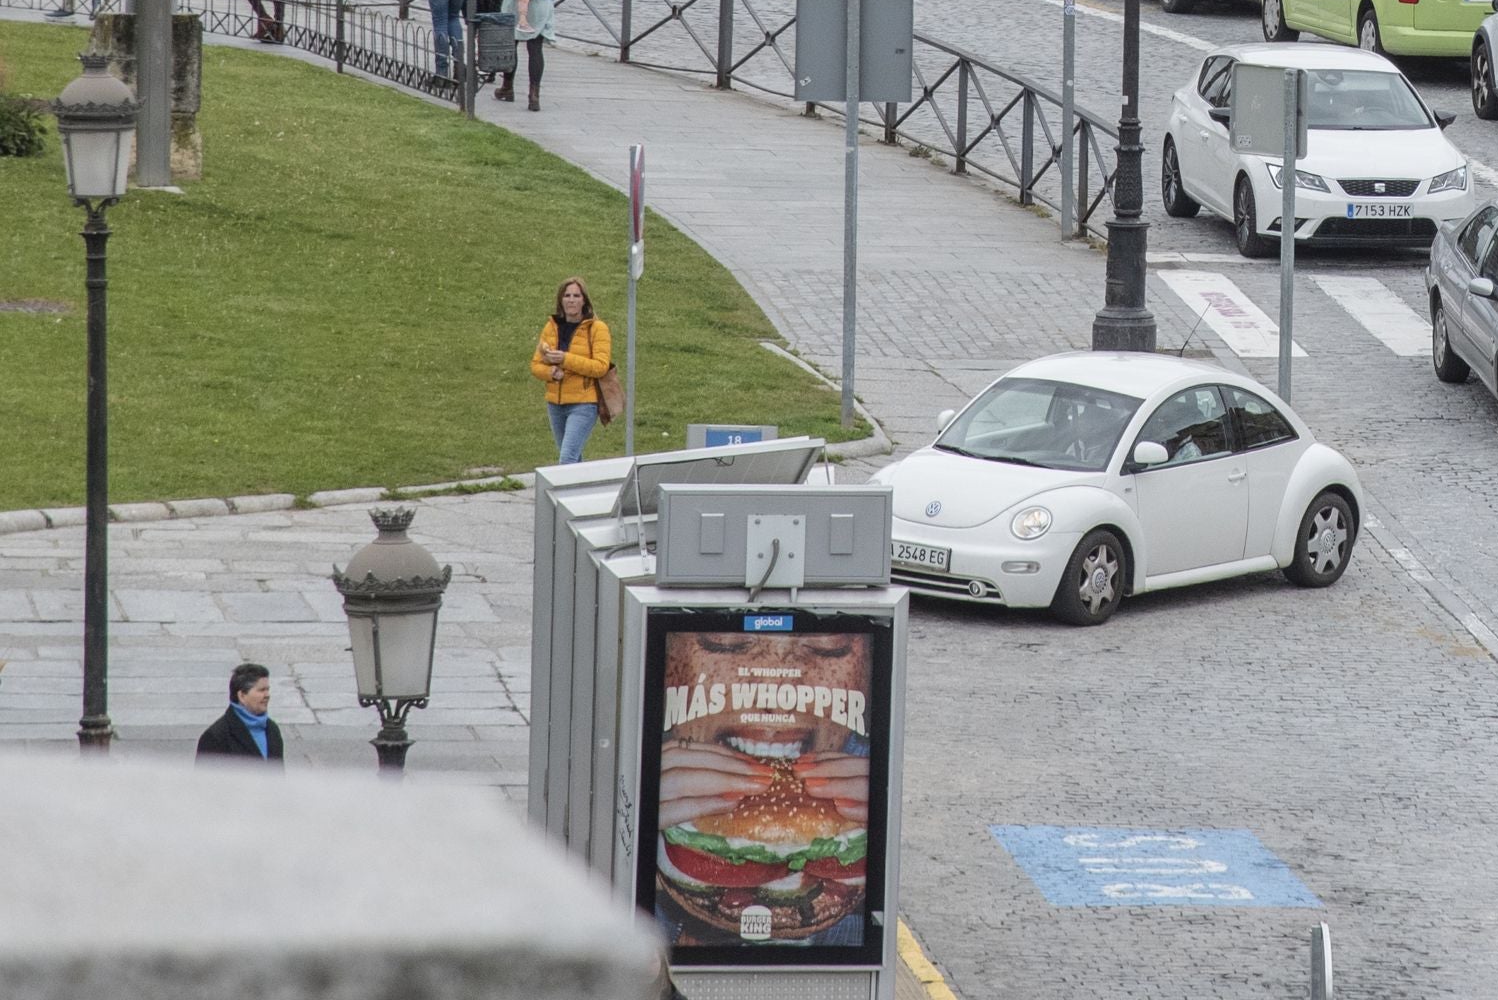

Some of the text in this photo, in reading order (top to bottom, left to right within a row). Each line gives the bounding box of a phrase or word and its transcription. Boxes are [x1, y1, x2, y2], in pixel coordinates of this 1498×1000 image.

[1355, 205, 1410, 216] 7153 HZK
[727, 435, 742, 445] 18
[898, 544, 945, 564] 2548 EG
[754, 617, 783, 630] global
[738, 668, 750, 677] EL
[664, 673, 866, 737] MÁS WHOPPER
[740, 713, 796, 724] QUE NUNCA
[741, 915, 771, 924] BURGER
[742, 922, 771, 934] KING
